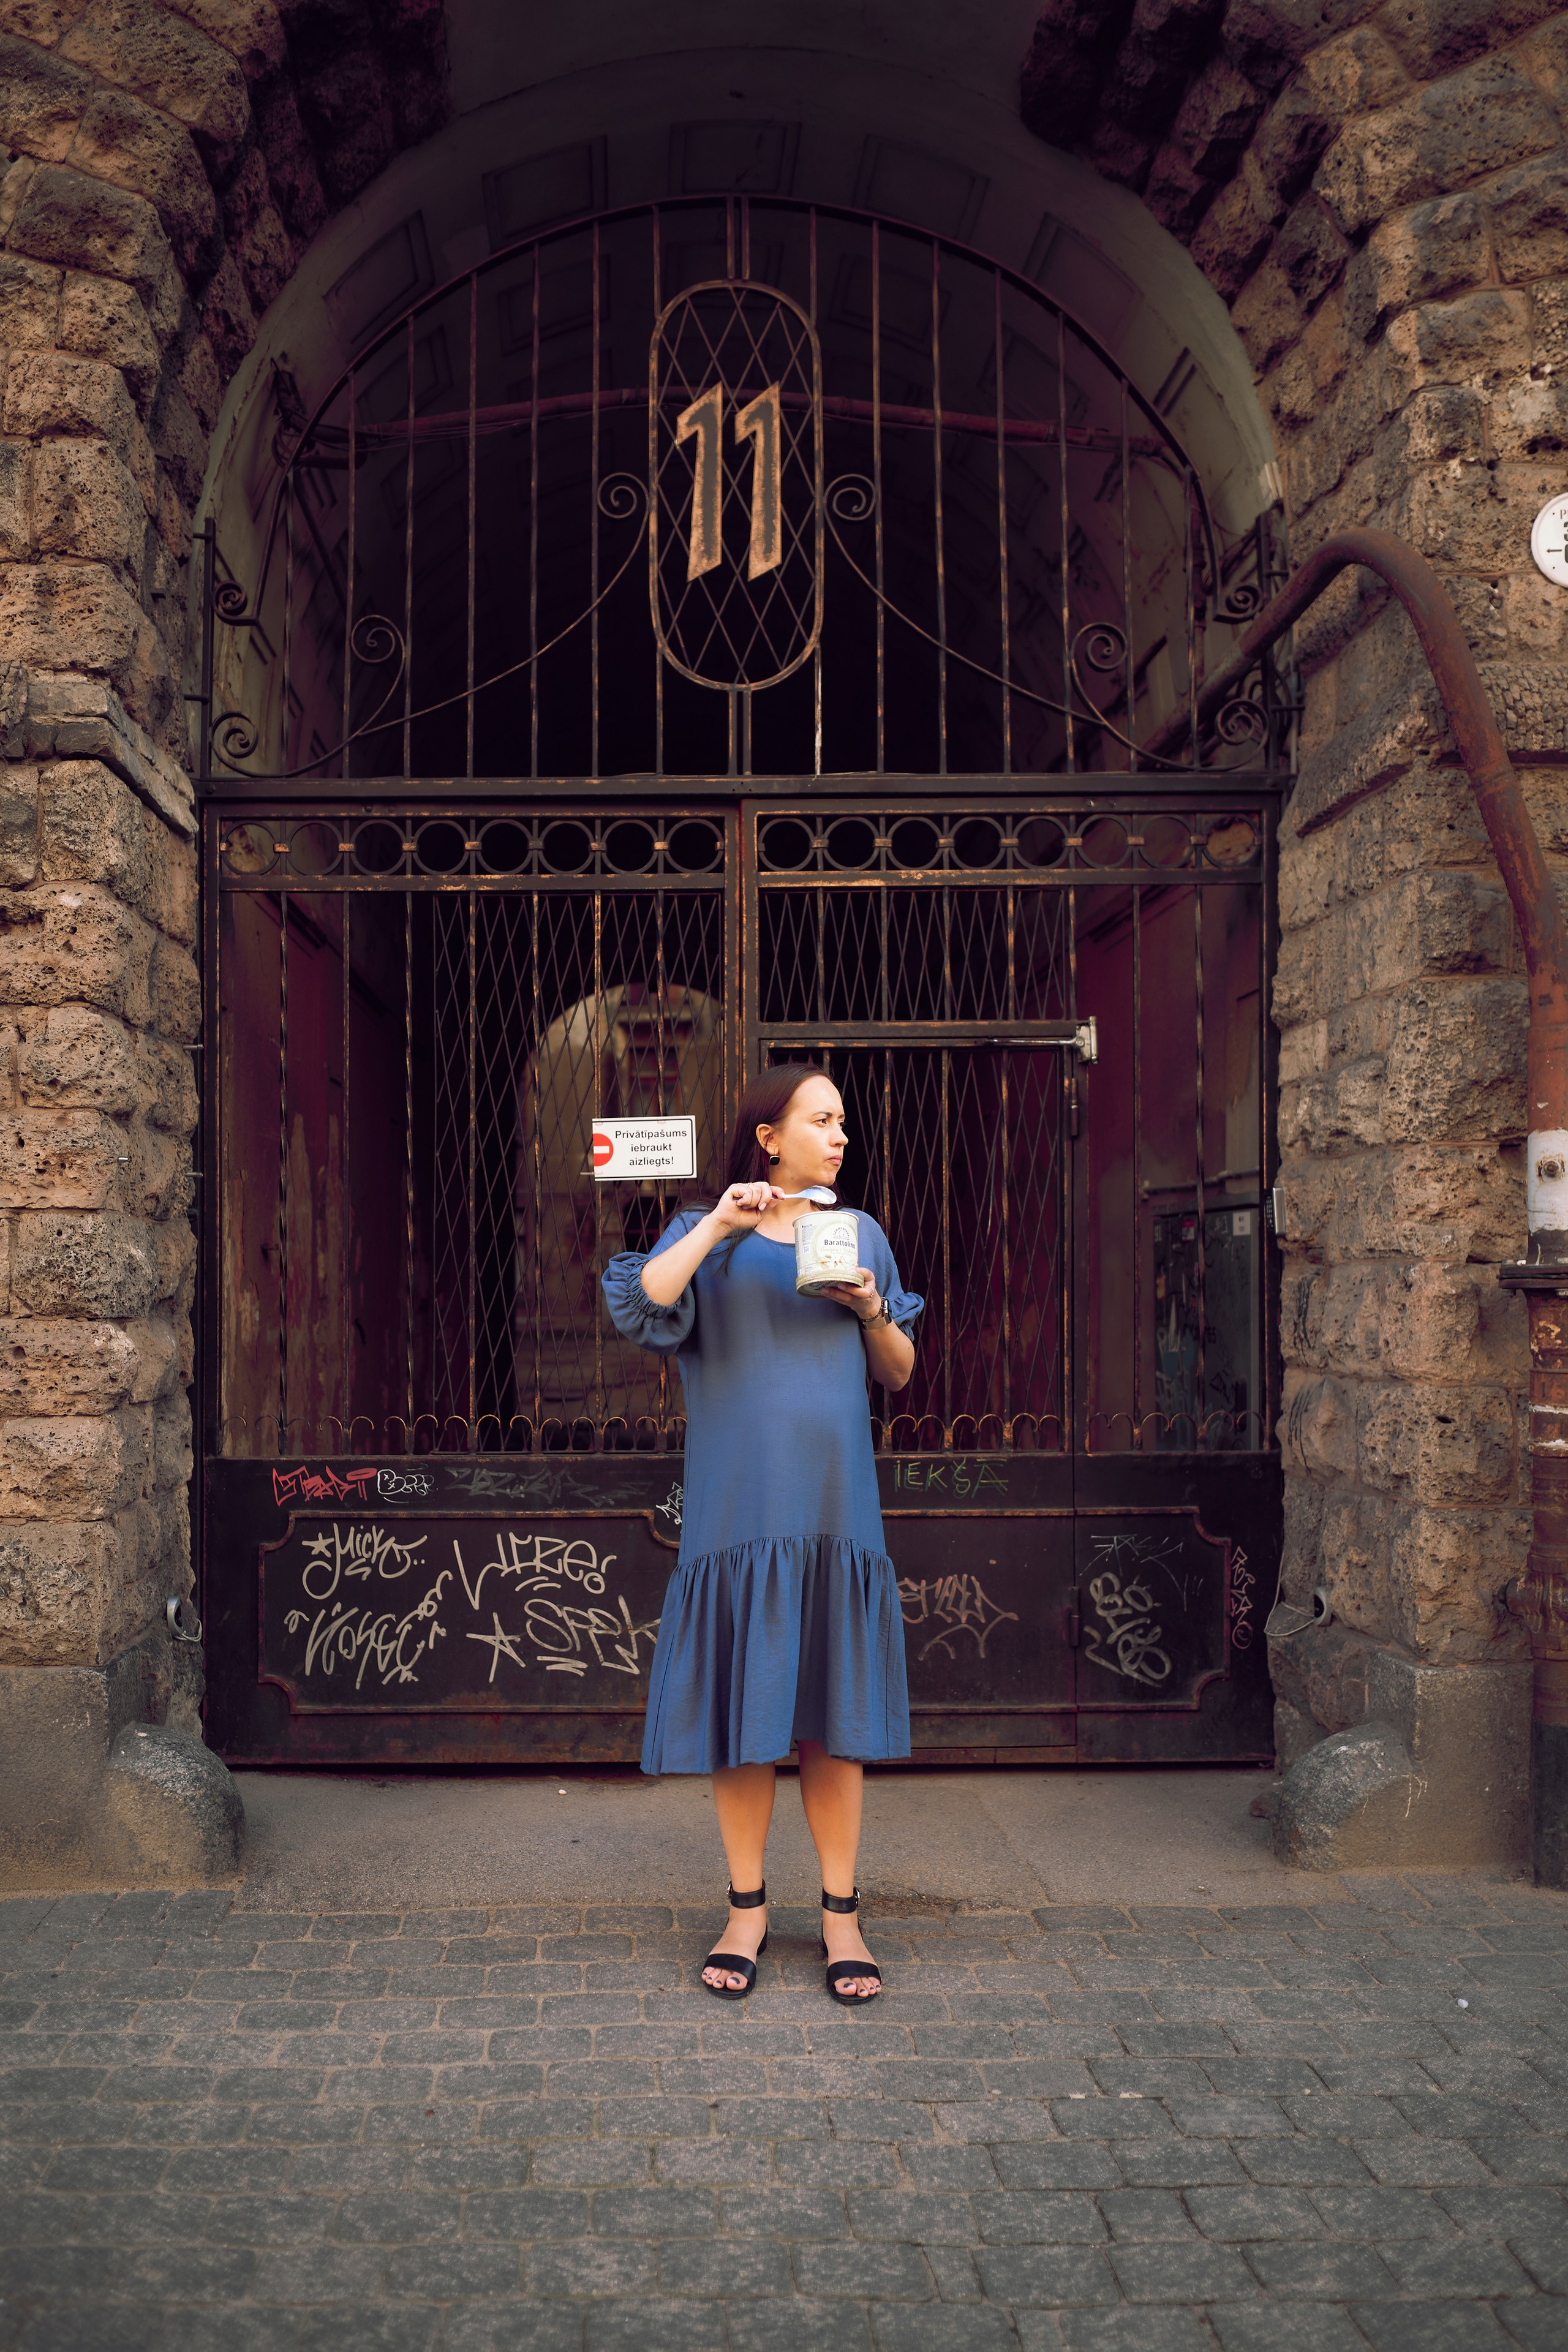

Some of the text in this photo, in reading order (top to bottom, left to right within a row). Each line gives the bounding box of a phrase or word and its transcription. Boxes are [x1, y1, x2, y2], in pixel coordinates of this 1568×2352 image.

[676, 380, 782, 582] 11
[615, 1129, 687, 1140] Privātīpašums
[631, 1143, 672, 1152] iebraukt
[629, 1156, 674, 1167] aizliegts!
[824, 1239, 856, 1249] Barattolino
